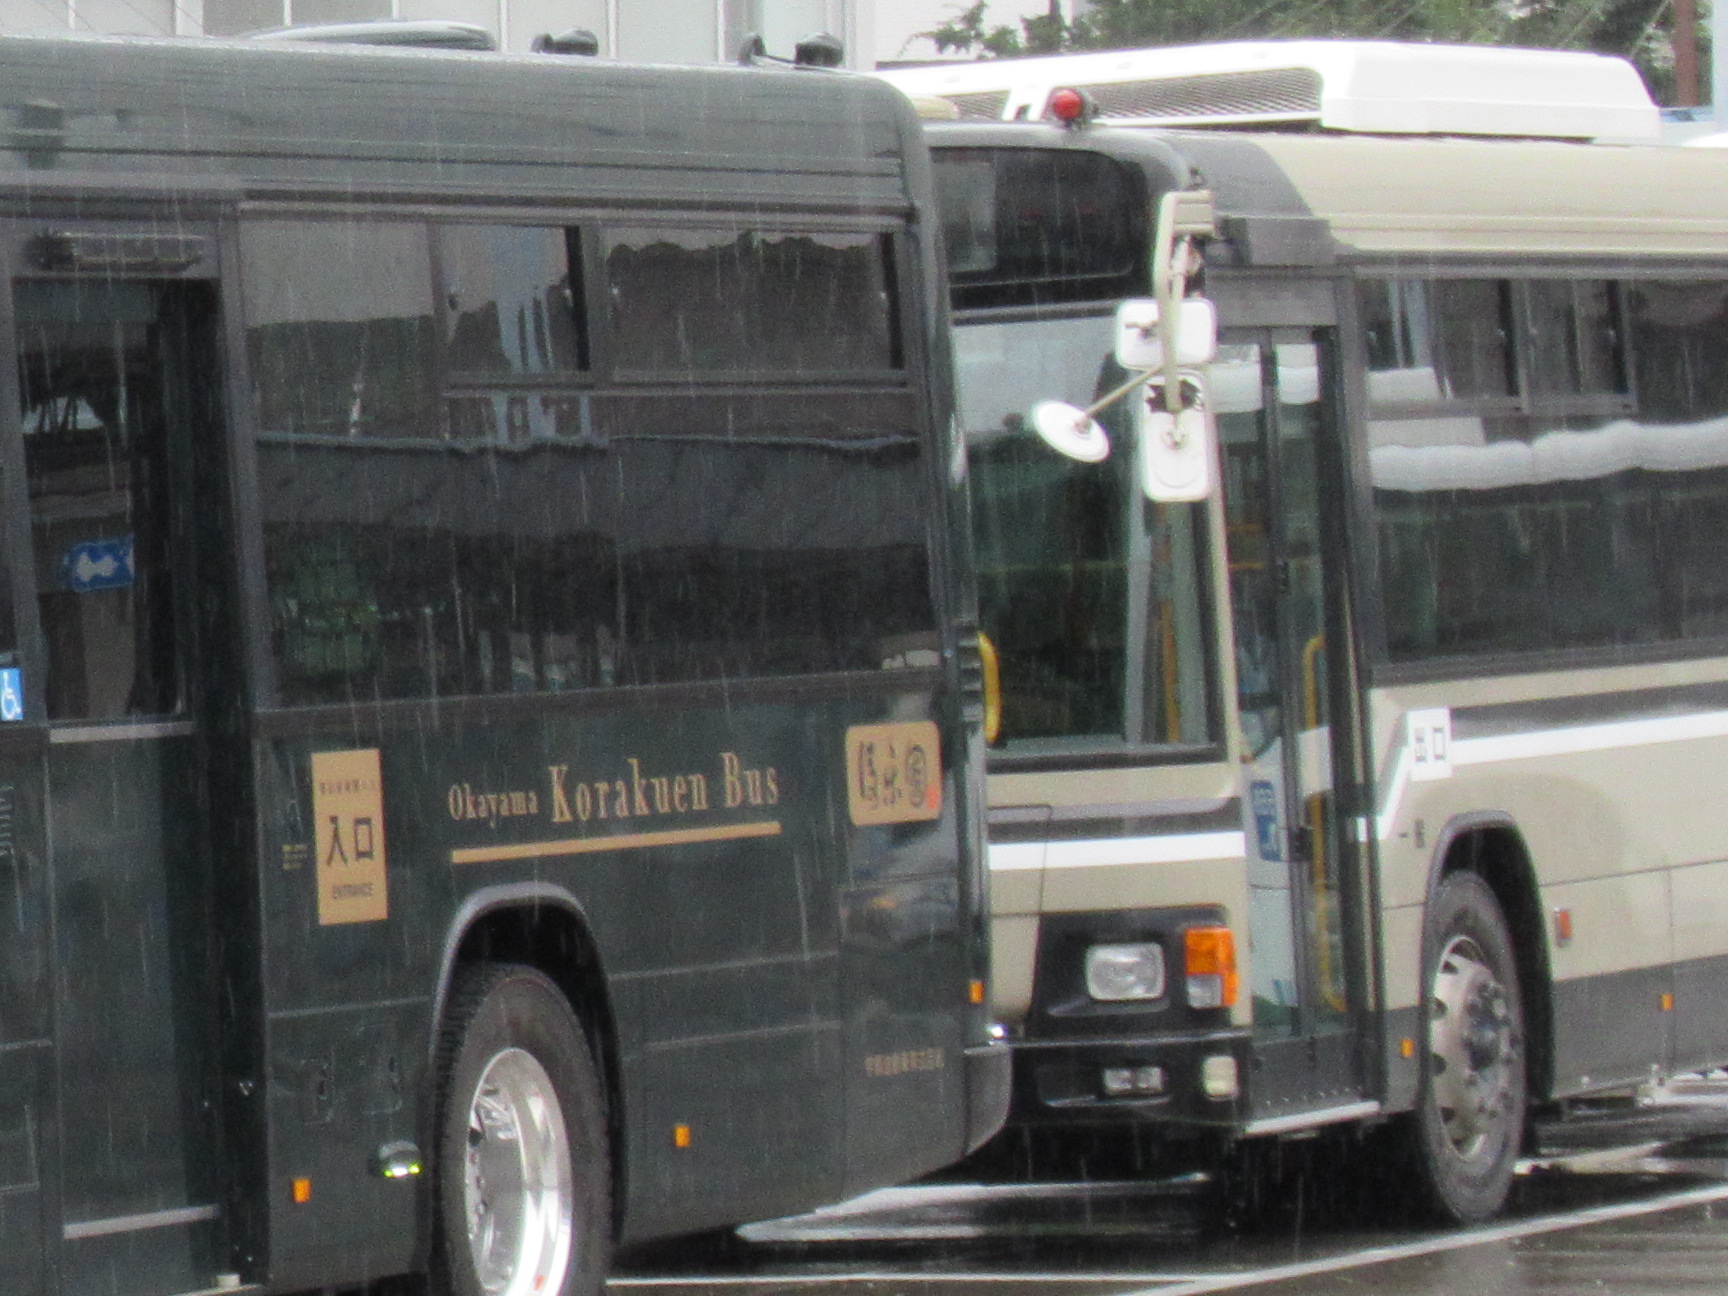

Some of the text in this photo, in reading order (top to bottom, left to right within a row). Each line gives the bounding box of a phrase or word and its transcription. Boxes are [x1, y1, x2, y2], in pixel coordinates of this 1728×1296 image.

[448, 752, 780, 829] Okayama Korakuen Bus
[326, 815, 374, 867] 入口
